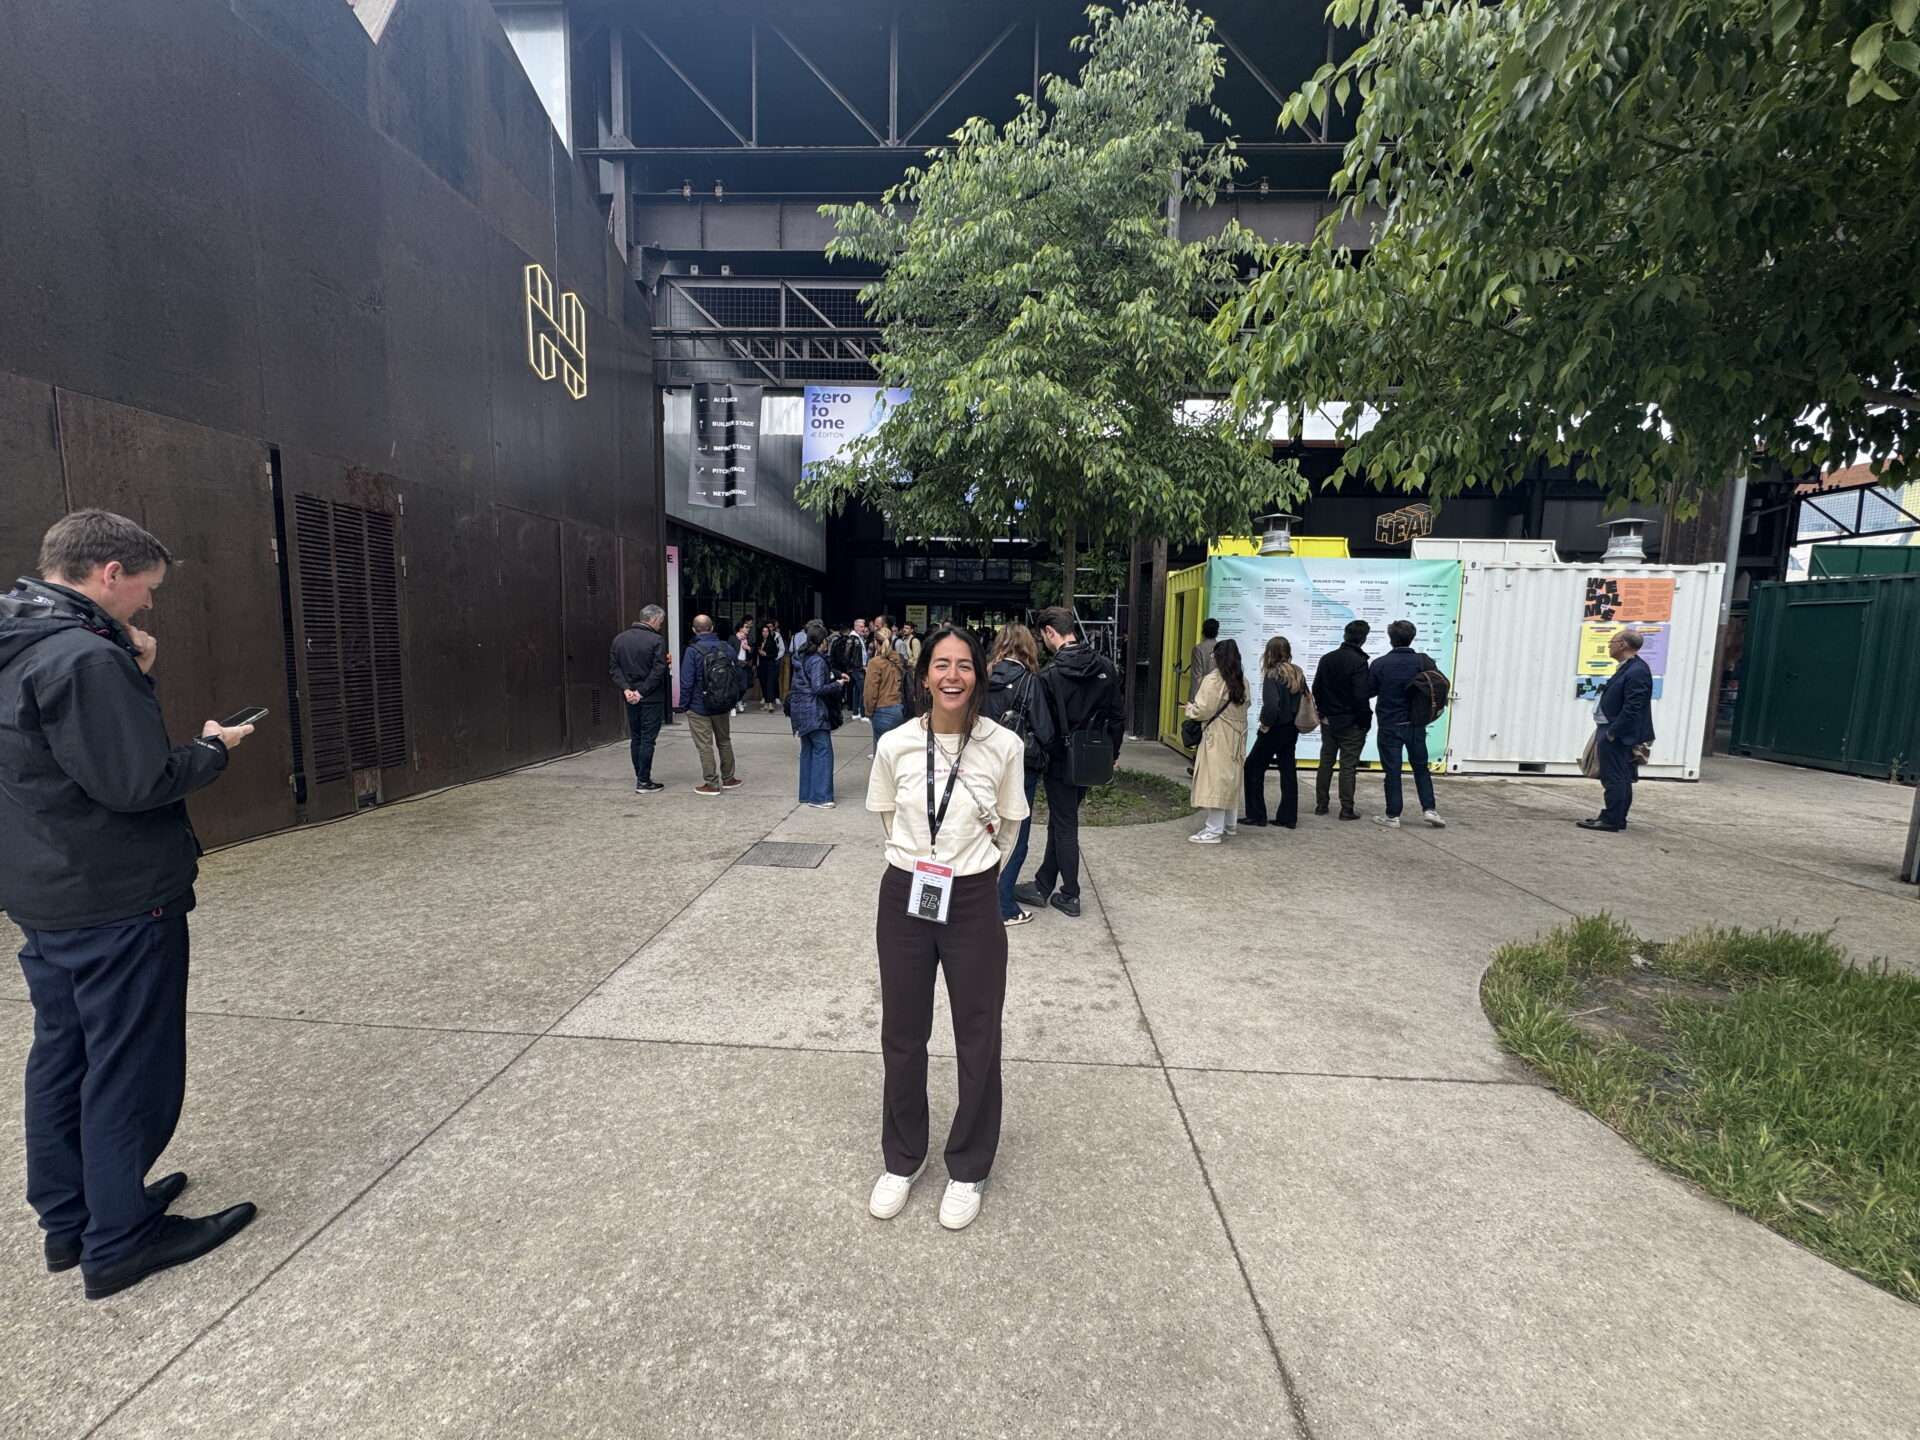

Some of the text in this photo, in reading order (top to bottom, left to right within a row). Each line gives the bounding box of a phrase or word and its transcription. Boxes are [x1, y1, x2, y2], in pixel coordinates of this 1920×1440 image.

[811, 392, 852, 403] zero
[811, 404, 829, 417] to
[811, 418, 845, 429] one
